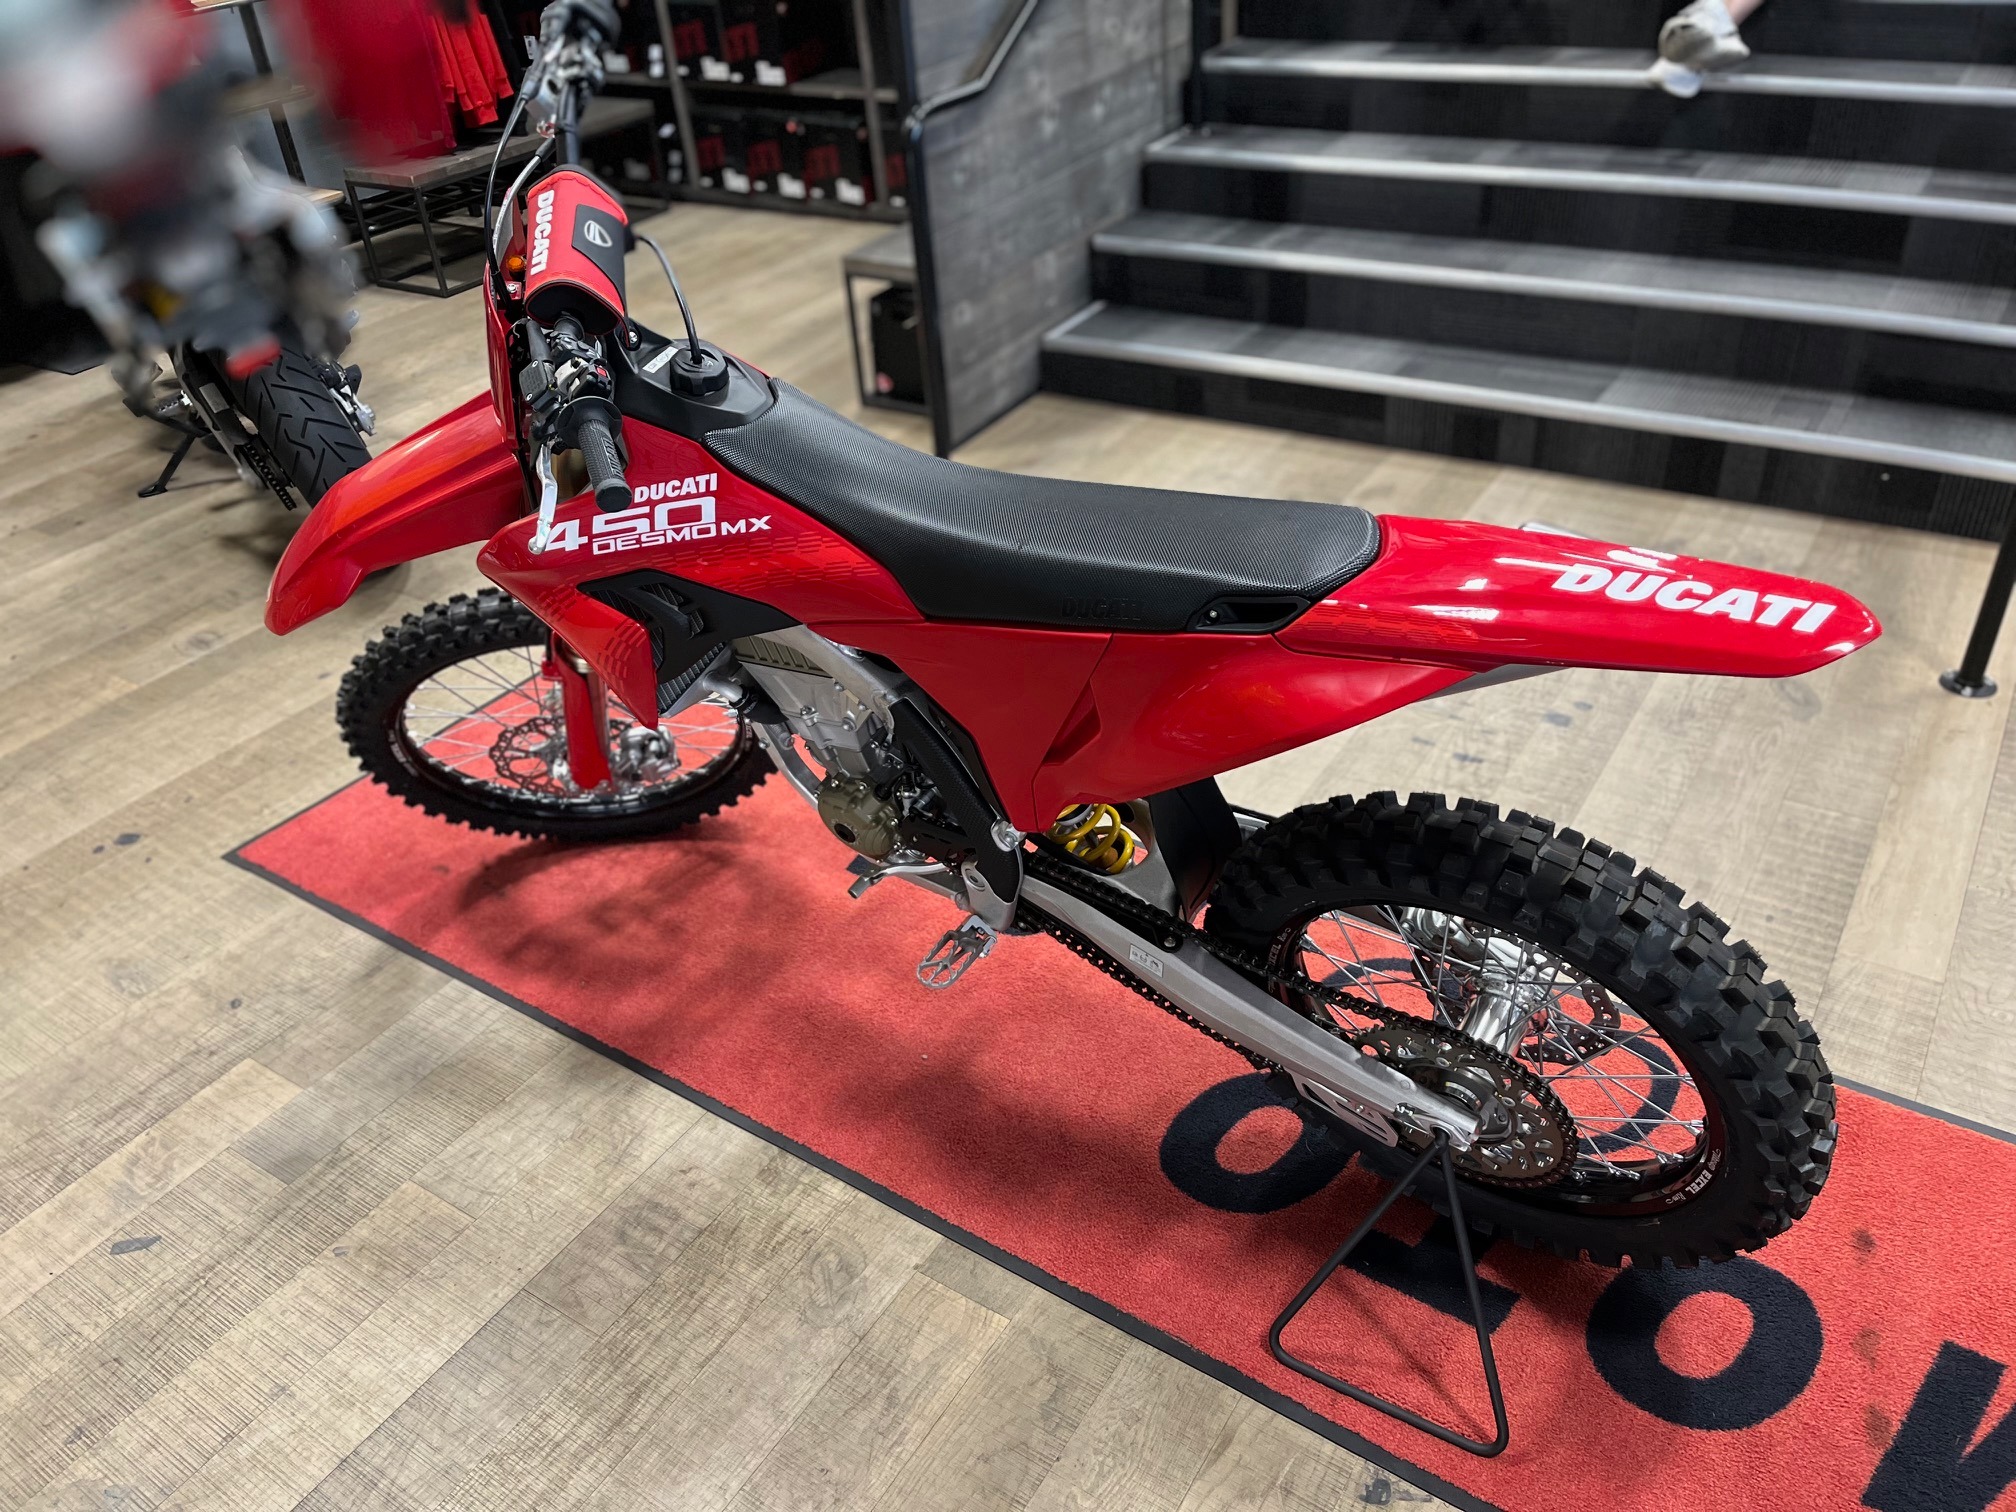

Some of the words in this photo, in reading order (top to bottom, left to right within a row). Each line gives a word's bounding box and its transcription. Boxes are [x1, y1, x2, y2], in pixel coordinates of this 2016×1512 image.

[530, 189, 555, 276] DUCATI
[633, 472, 718, 503] DUCATI
[545, 496, 716, 552] 450
[592, 523, 717, 555] DESMO
[721, 514, 772, 535] MX
[1551, 563, 1837, 633] DUCATI
[1684, 1168, 1713, 1195] EXCEL
